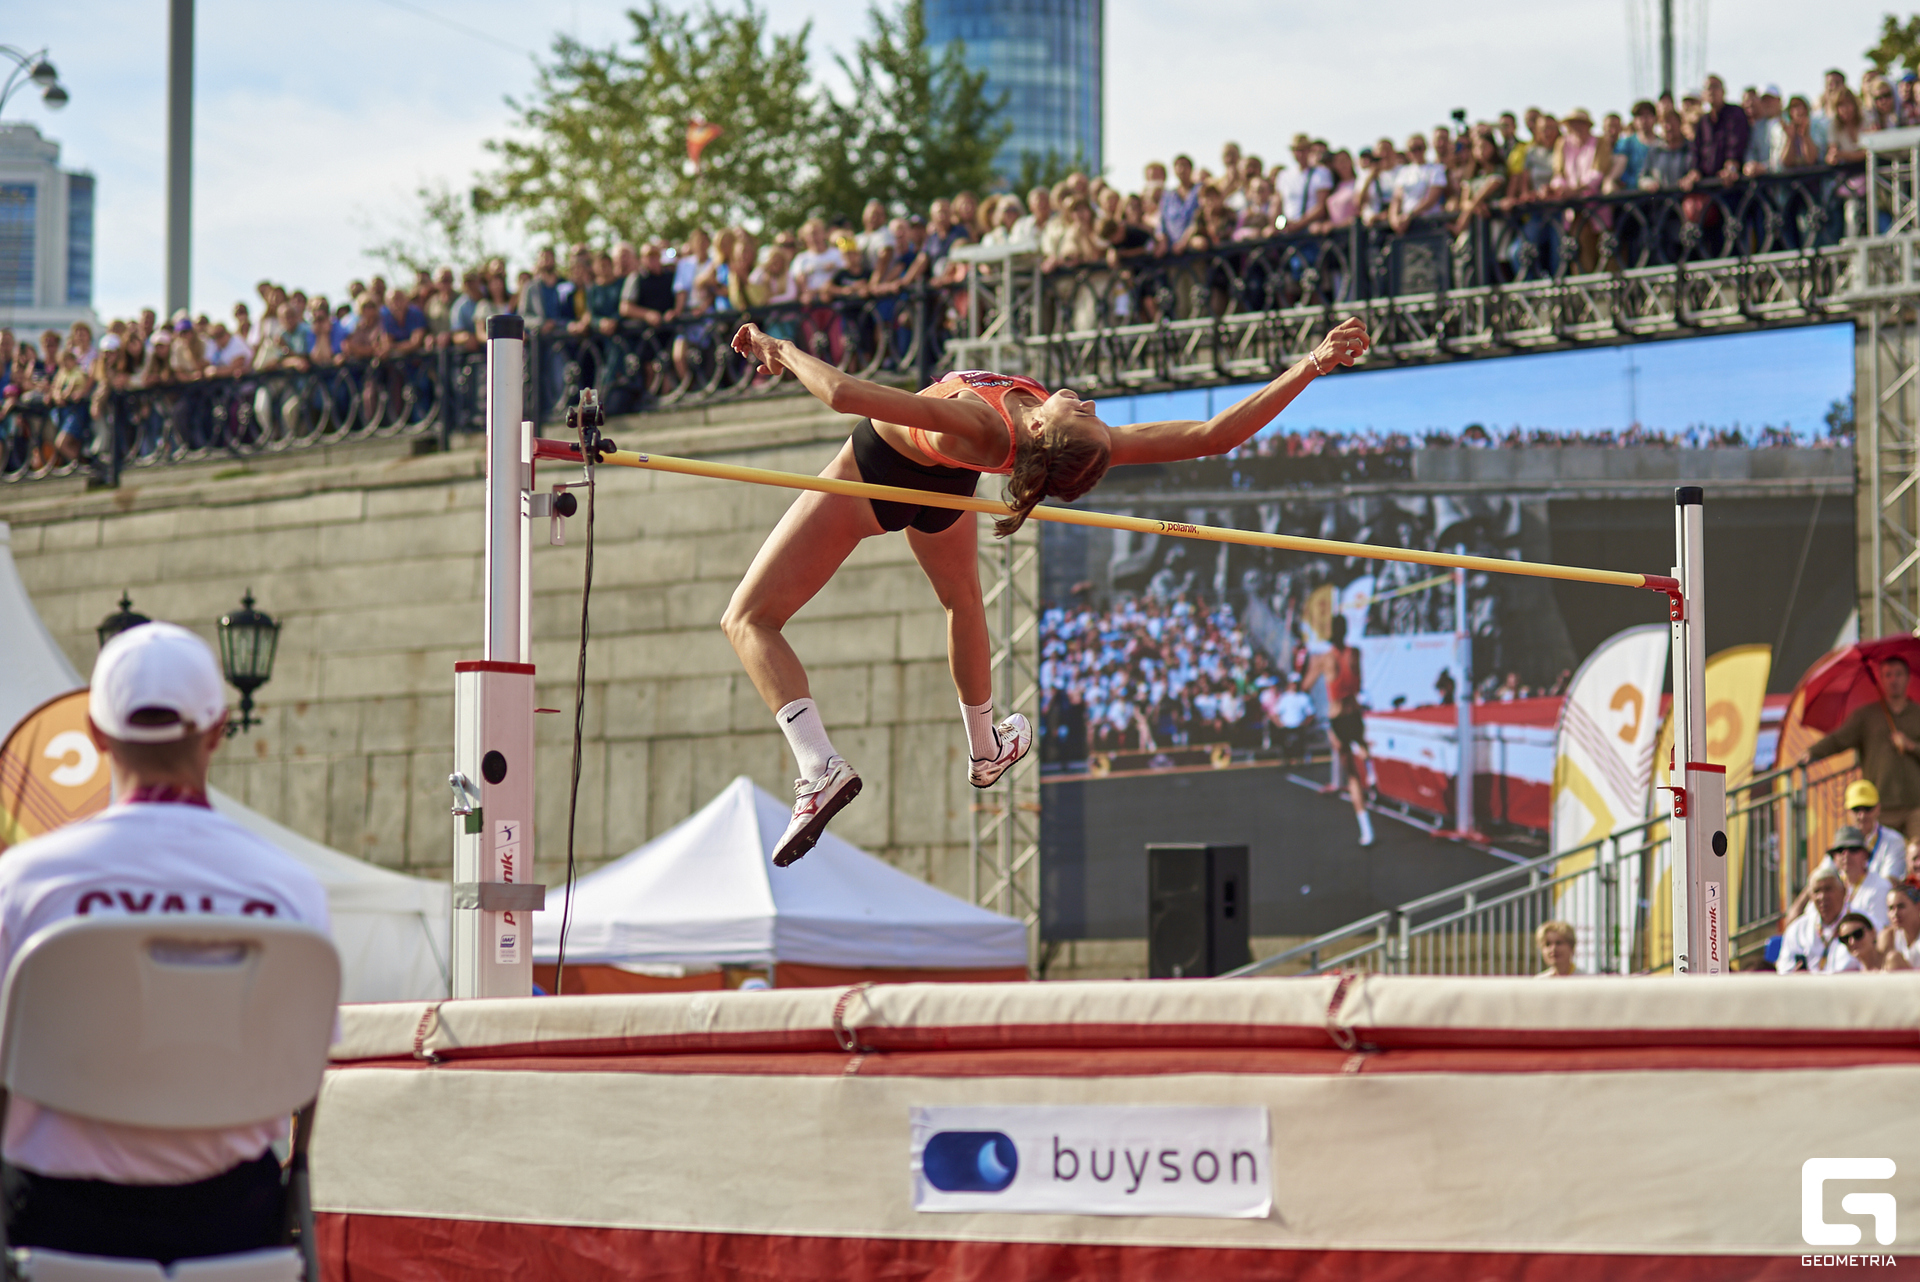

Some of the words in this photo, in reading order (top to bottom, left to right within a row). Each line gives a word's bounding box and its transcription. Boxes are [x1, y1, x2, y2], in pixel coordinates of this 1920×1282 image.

[1166, 522, 1199, 534] polanik
[500, 852, 517, 926] pnik
[1708, 906, 1720, 962] polanik
[1053, 1135, 1257, 1195] buyson
